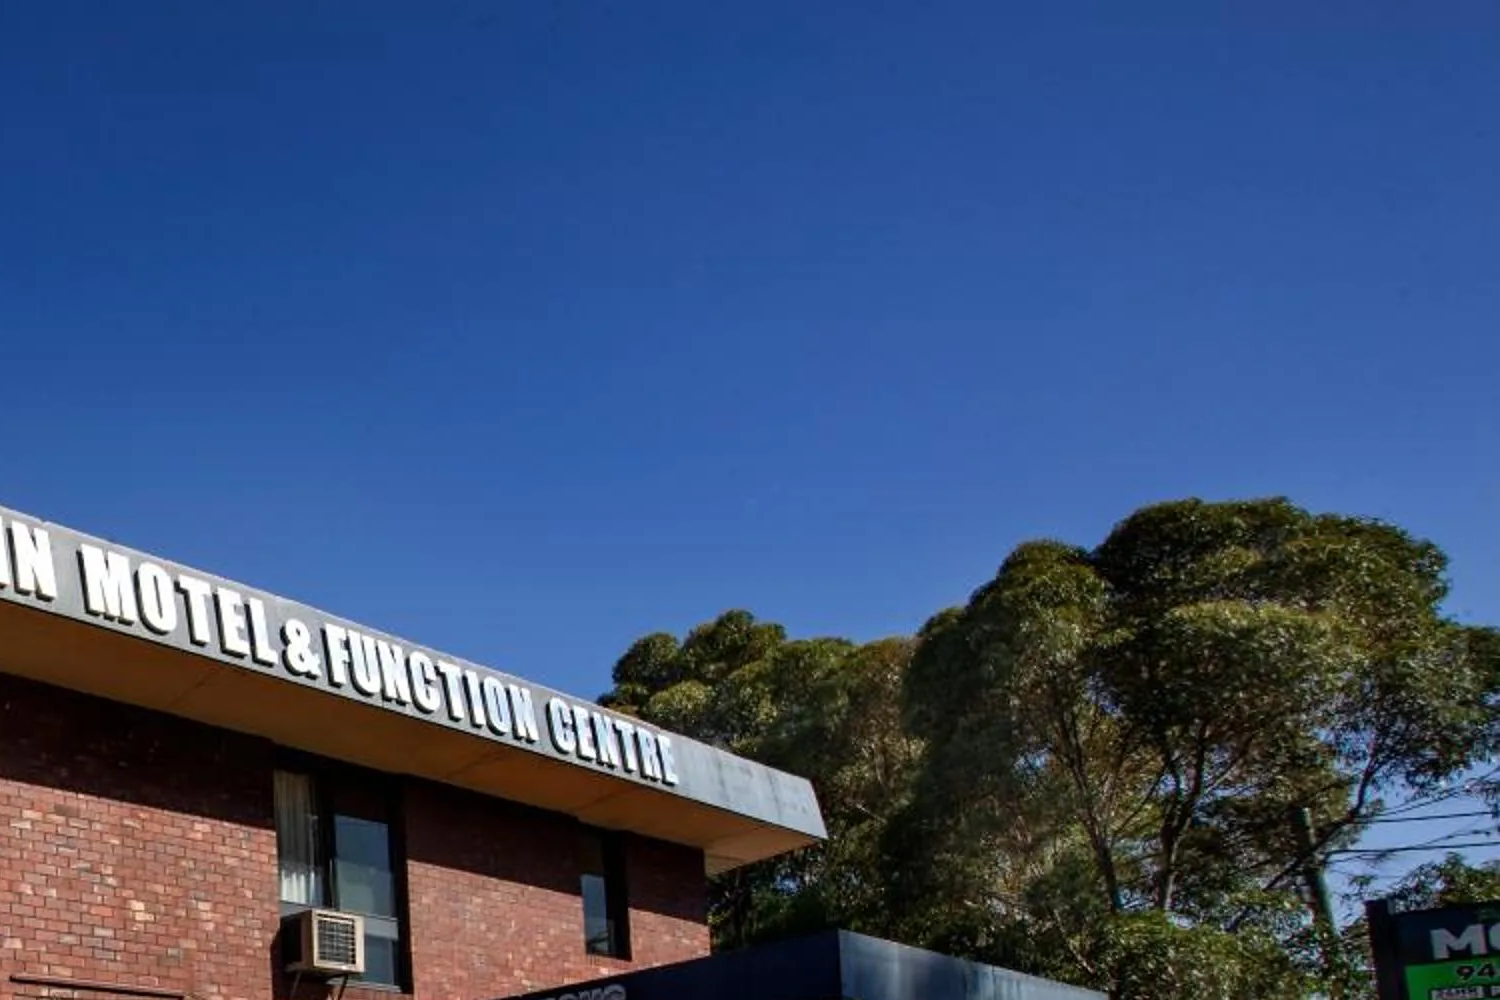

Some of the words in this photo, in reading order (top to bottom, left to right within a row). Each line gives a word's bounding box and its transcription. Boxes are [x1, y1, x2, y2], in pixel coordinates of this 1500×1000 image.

[77, 543, 279, 666] MOTEL
[281, 618, 323, 681] &
[322, 624, 539, 744] FUNCTION
[547, 697, 680, 786] CENTRE
